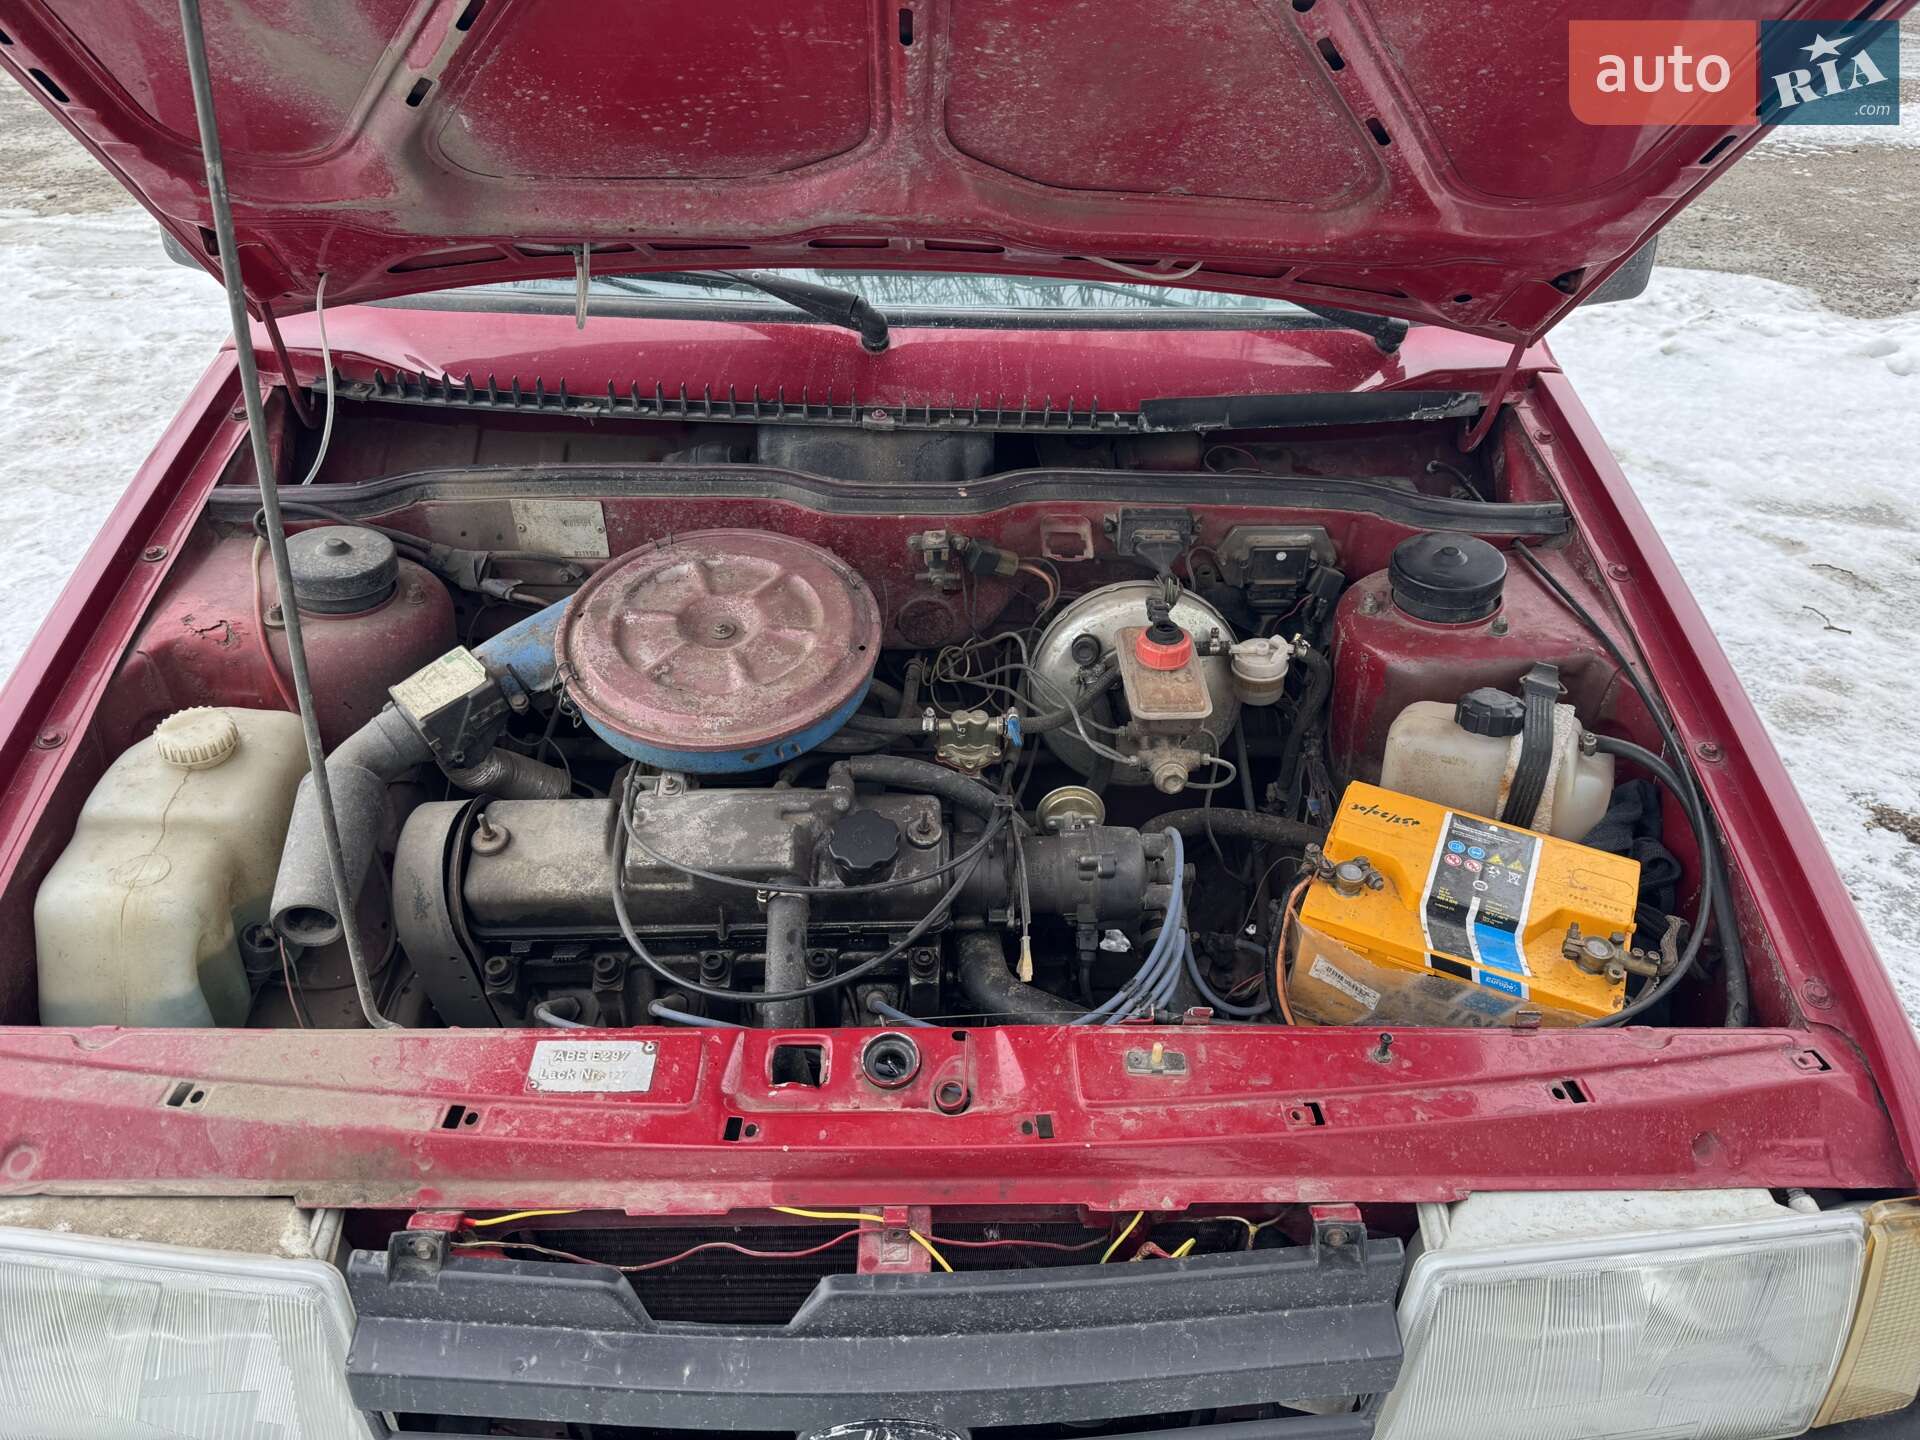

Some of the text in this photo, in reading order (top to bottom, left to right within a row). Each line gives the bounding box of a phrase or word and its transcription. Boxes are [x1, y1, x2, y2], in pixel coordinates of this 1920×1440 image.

[552, 1050, 630, 1062] ABE E297
[539, 1068, 576, 1080] Lack
